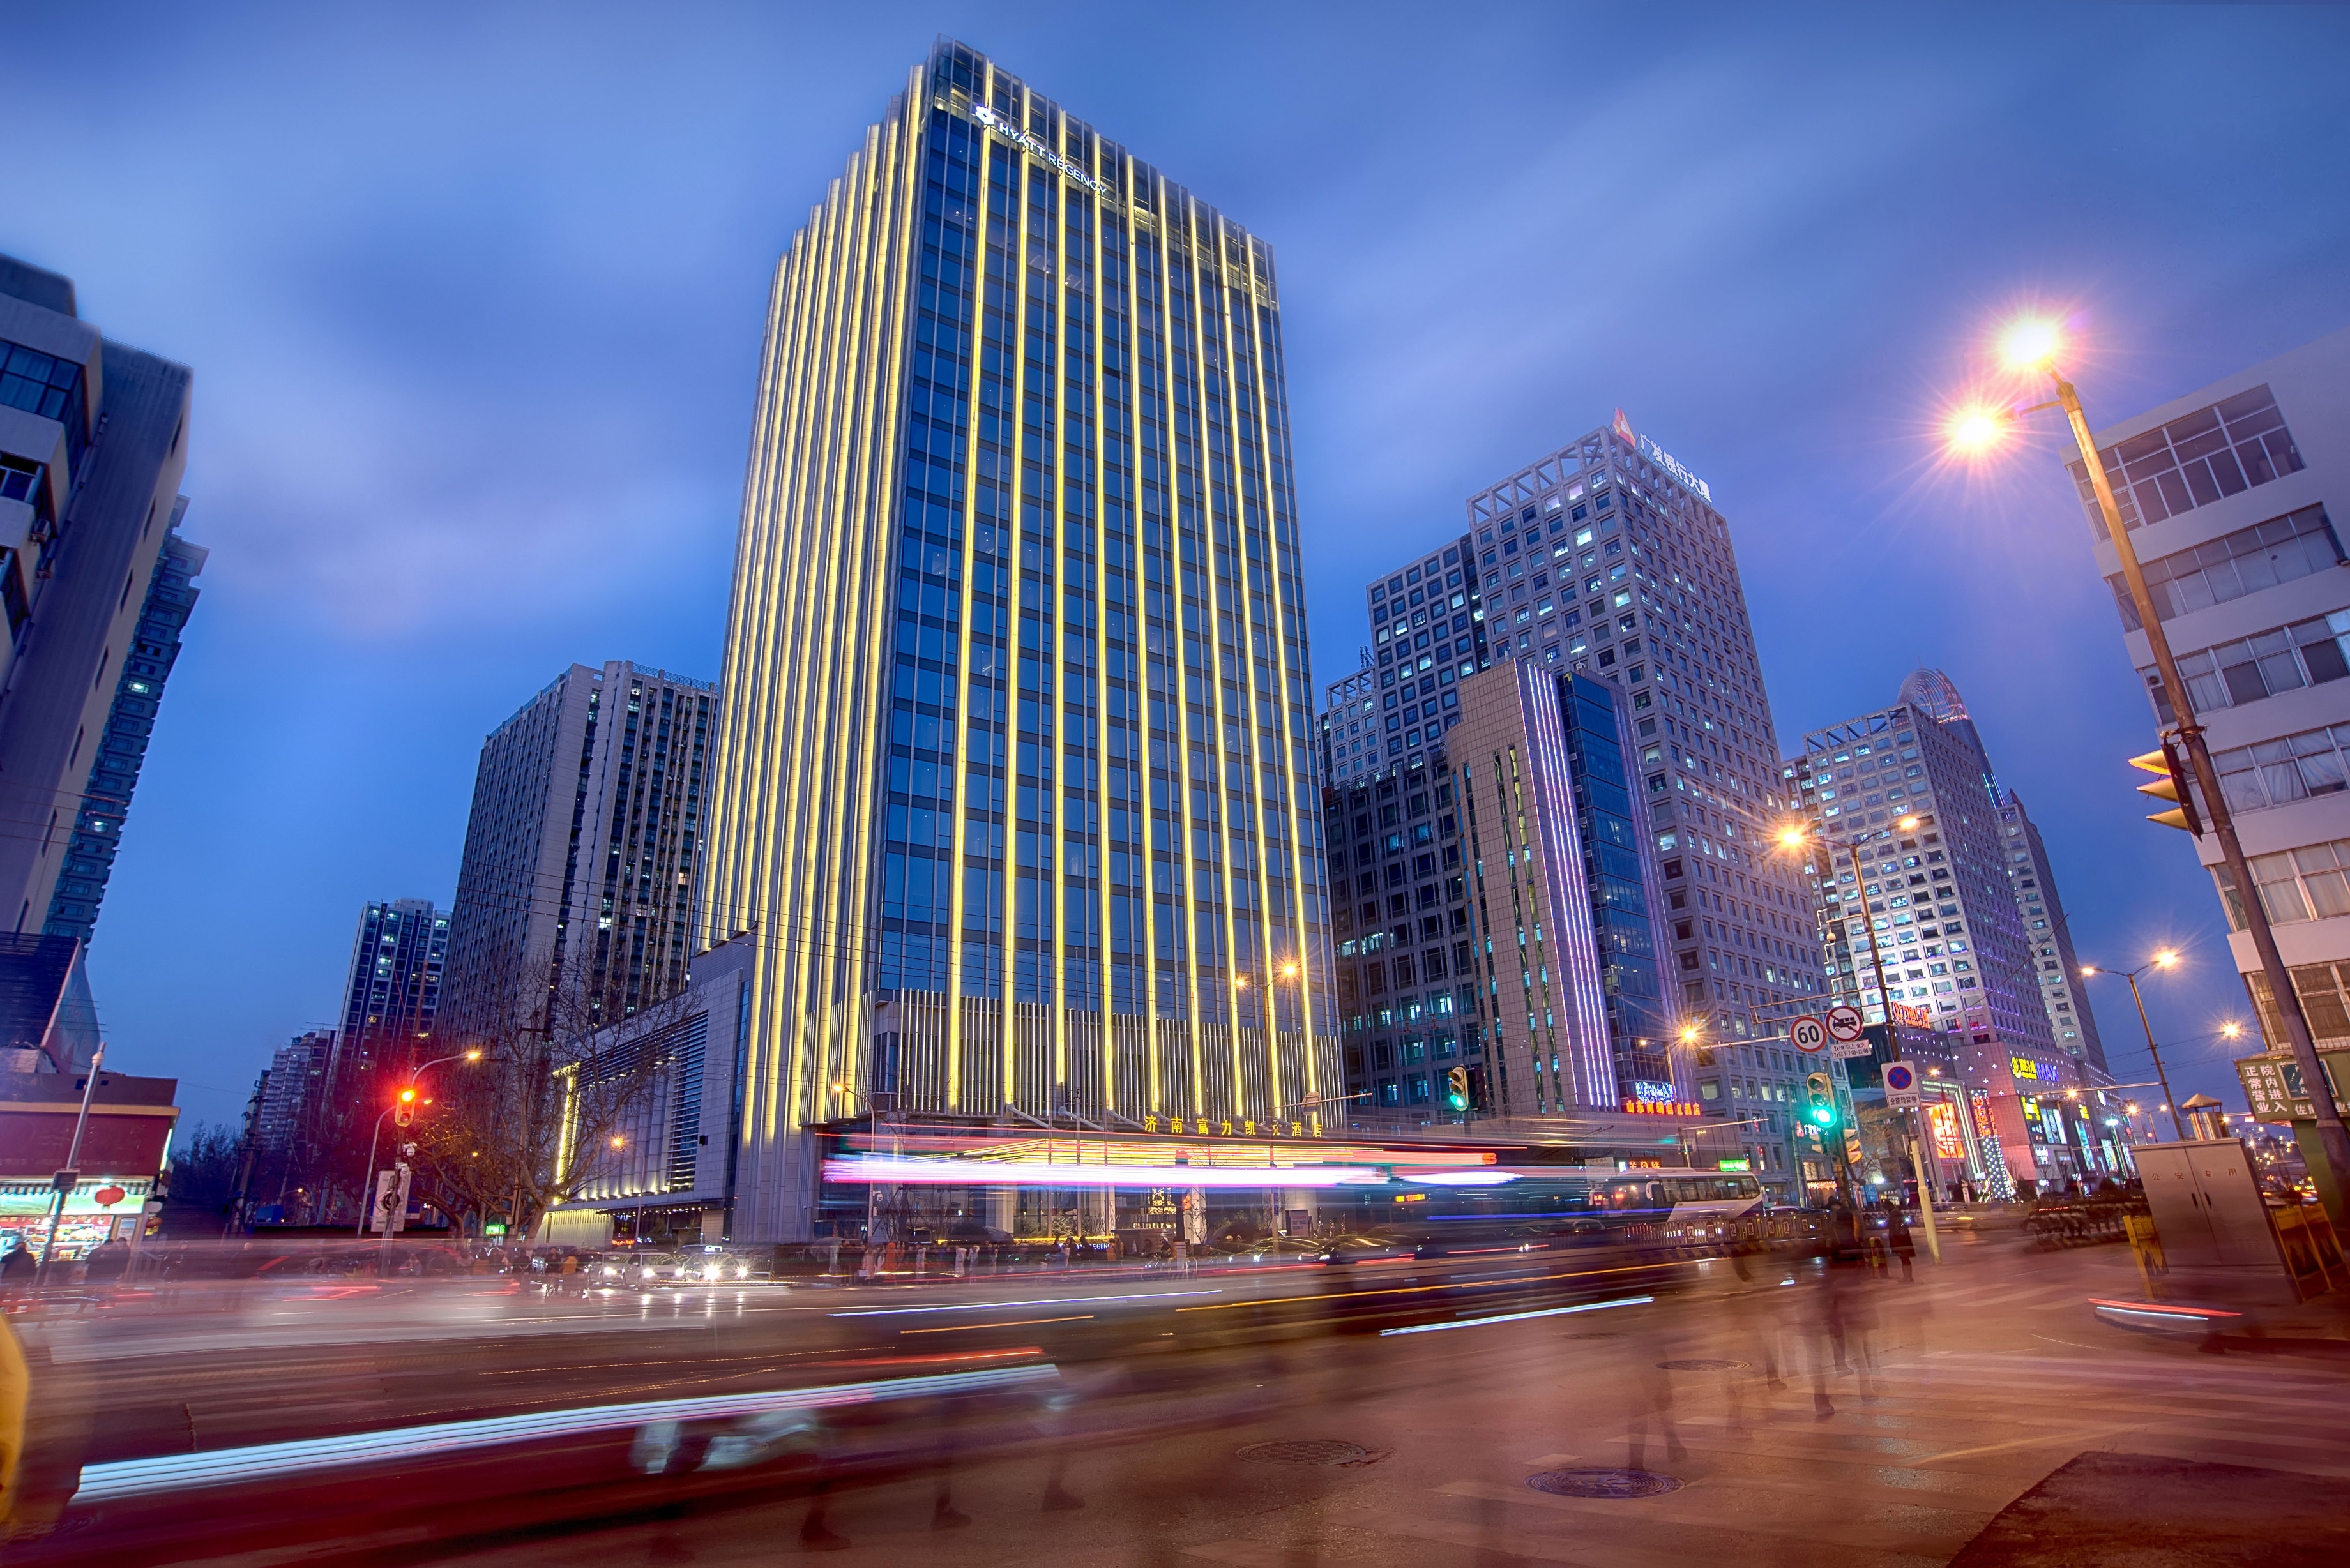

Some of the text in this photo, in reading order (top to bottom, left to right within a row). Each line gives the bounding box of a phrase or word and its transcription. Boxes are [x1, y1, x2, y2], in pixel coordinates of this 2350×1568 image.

[999, 121, 1107, 195] HYATT REGENCY
[1797, 1025, 1820, 1044] 60
[1890, 1095, 1918, 1106] 全路段禁停
[2244, 1066, 2271, 1113] 正常营业
[2259, 1064, 2288, 1113] 院内进入
[2151, 1168, 2237, 1180] 公安专用
